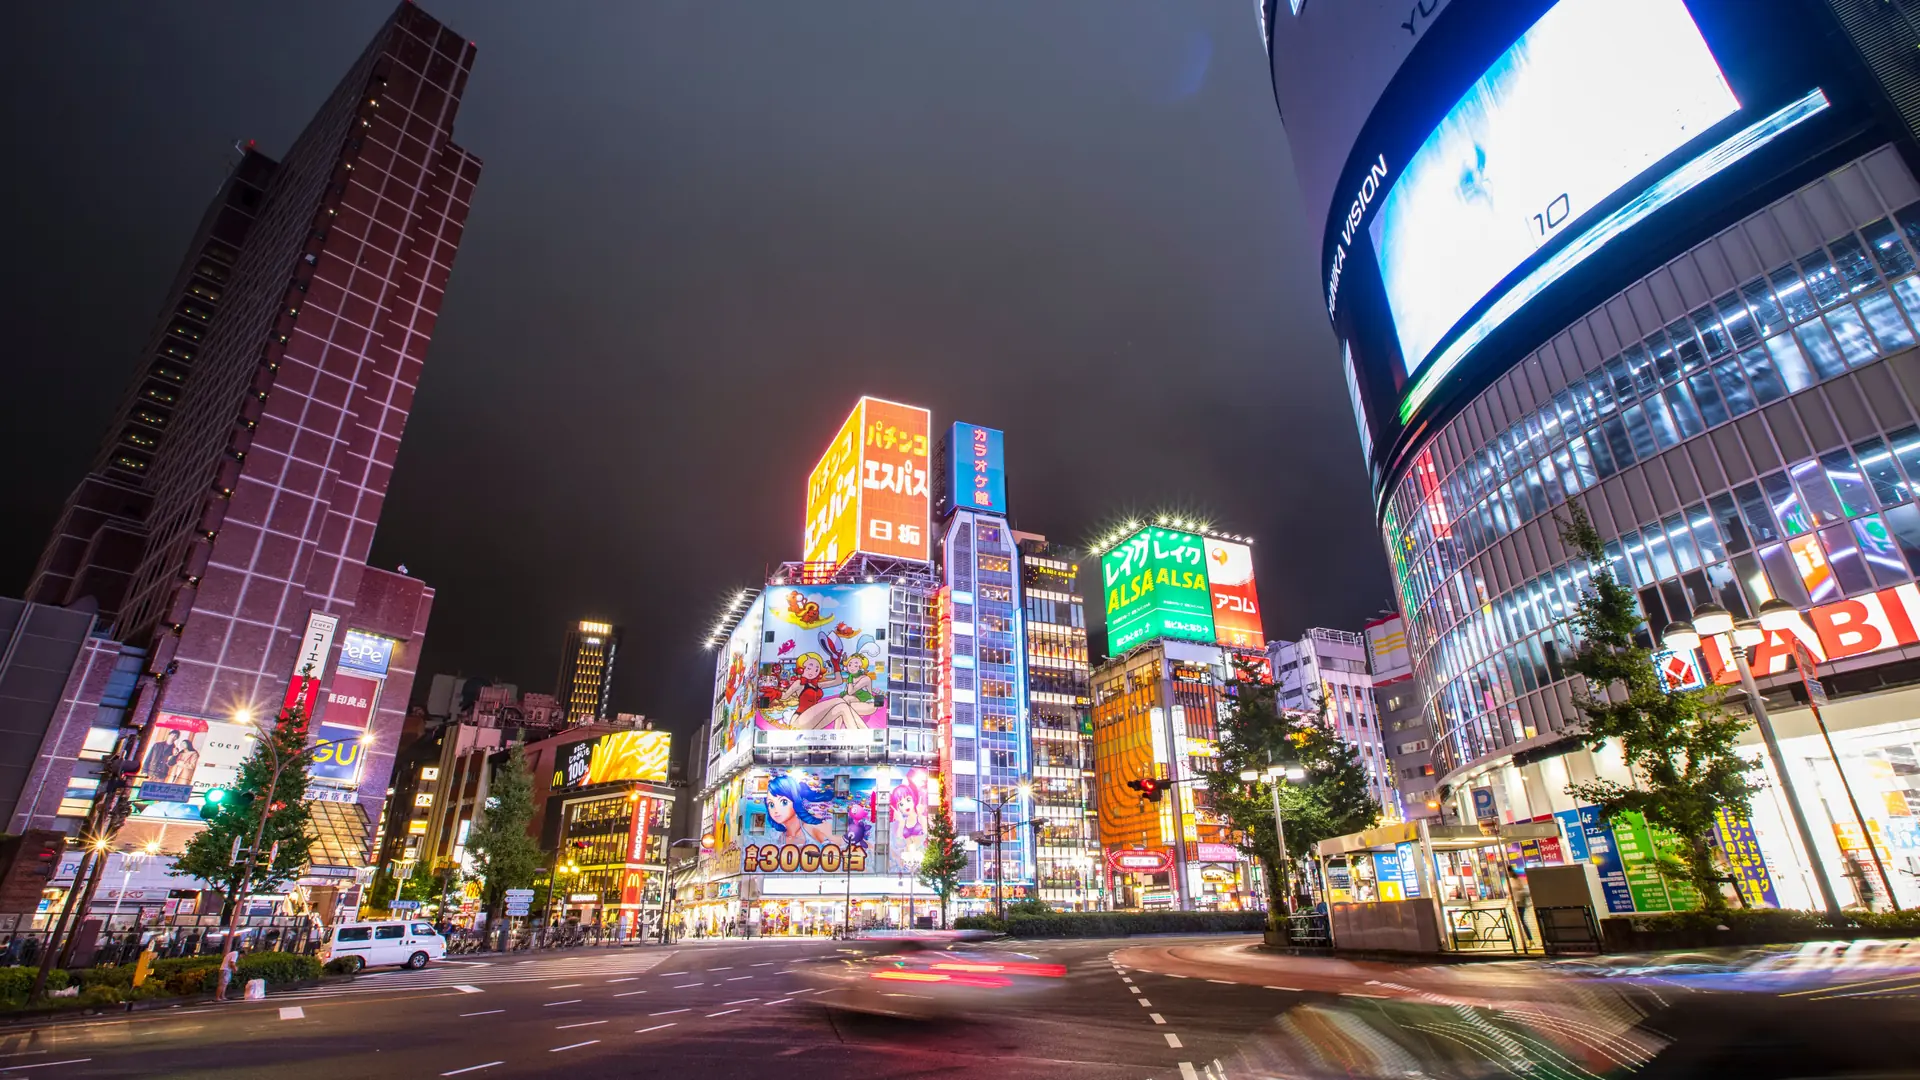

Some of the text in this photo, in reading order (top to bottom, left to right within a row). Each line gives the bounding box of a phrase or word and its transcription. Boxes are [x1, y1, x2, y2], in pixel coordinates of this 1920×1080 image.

[1341, 152, 1389, 247] VISION
[1533, 192, 1570, 236] 10
[866, 420, 928, 457] パチンコ
[811, 430, 854, 508] パチンコ
[863, 459, 929, 499] エスパス
[973, 428, 989, 506] カラオケ館
[804, 465, 857, 561] エスパス
[869, 518, 920, 546] 日拓
[1105, 533, 1150, 587] レイク
[1153, 540, 1200, 566] レイク
[1107, 568, 1154, 614] ALSA
[1156, 568, 1206, 591] ALSA
[1214, 593, 1256, 614] アコム
[209, 741, 240, 750] coen
[312, 738, 358, 766] GU
